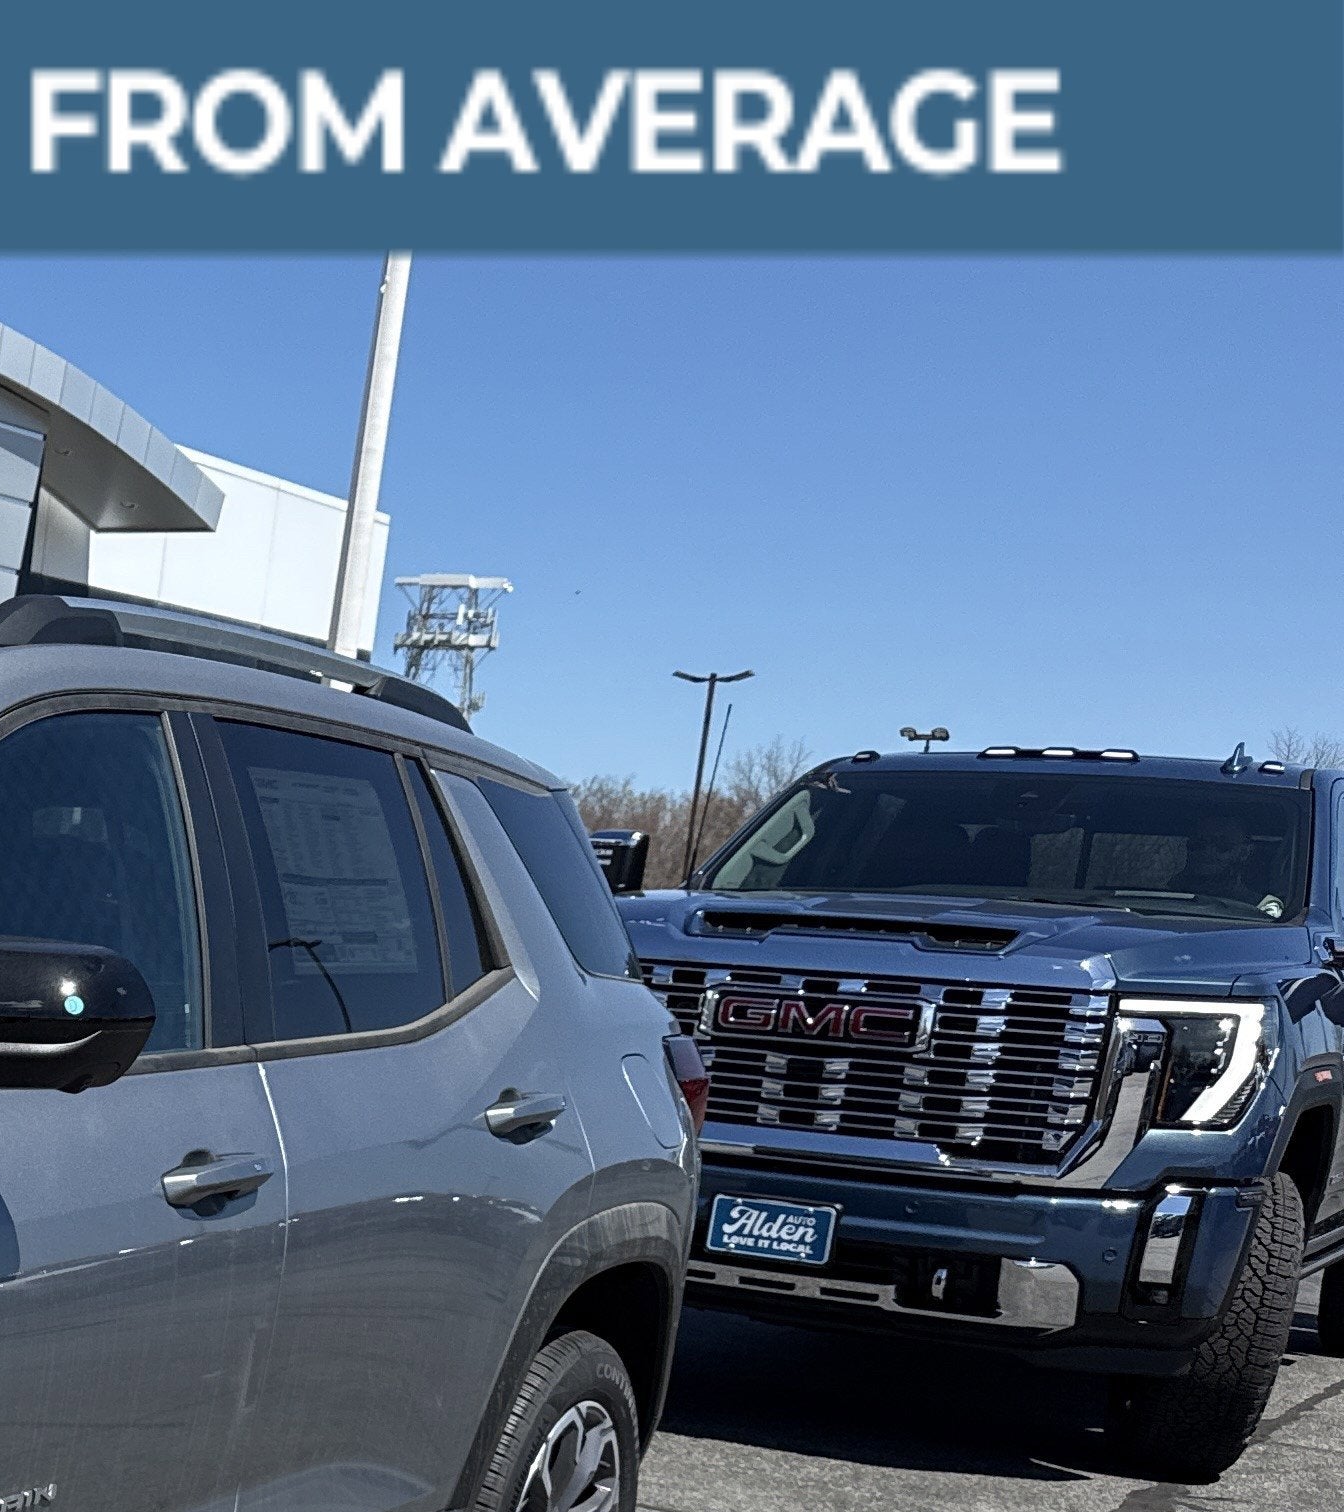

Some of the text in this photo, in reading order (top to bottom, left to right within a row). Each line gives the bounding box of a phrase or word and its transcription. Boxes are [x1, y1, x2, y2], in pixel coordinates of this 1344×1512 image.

[718, 994, 914, 1043] GMC
[721, 1205, 818, 1243] Alden
[785, 1214, 817, 1227] AUTO
[722, 1233, 814, 1255] LOVE IT LOCAL
